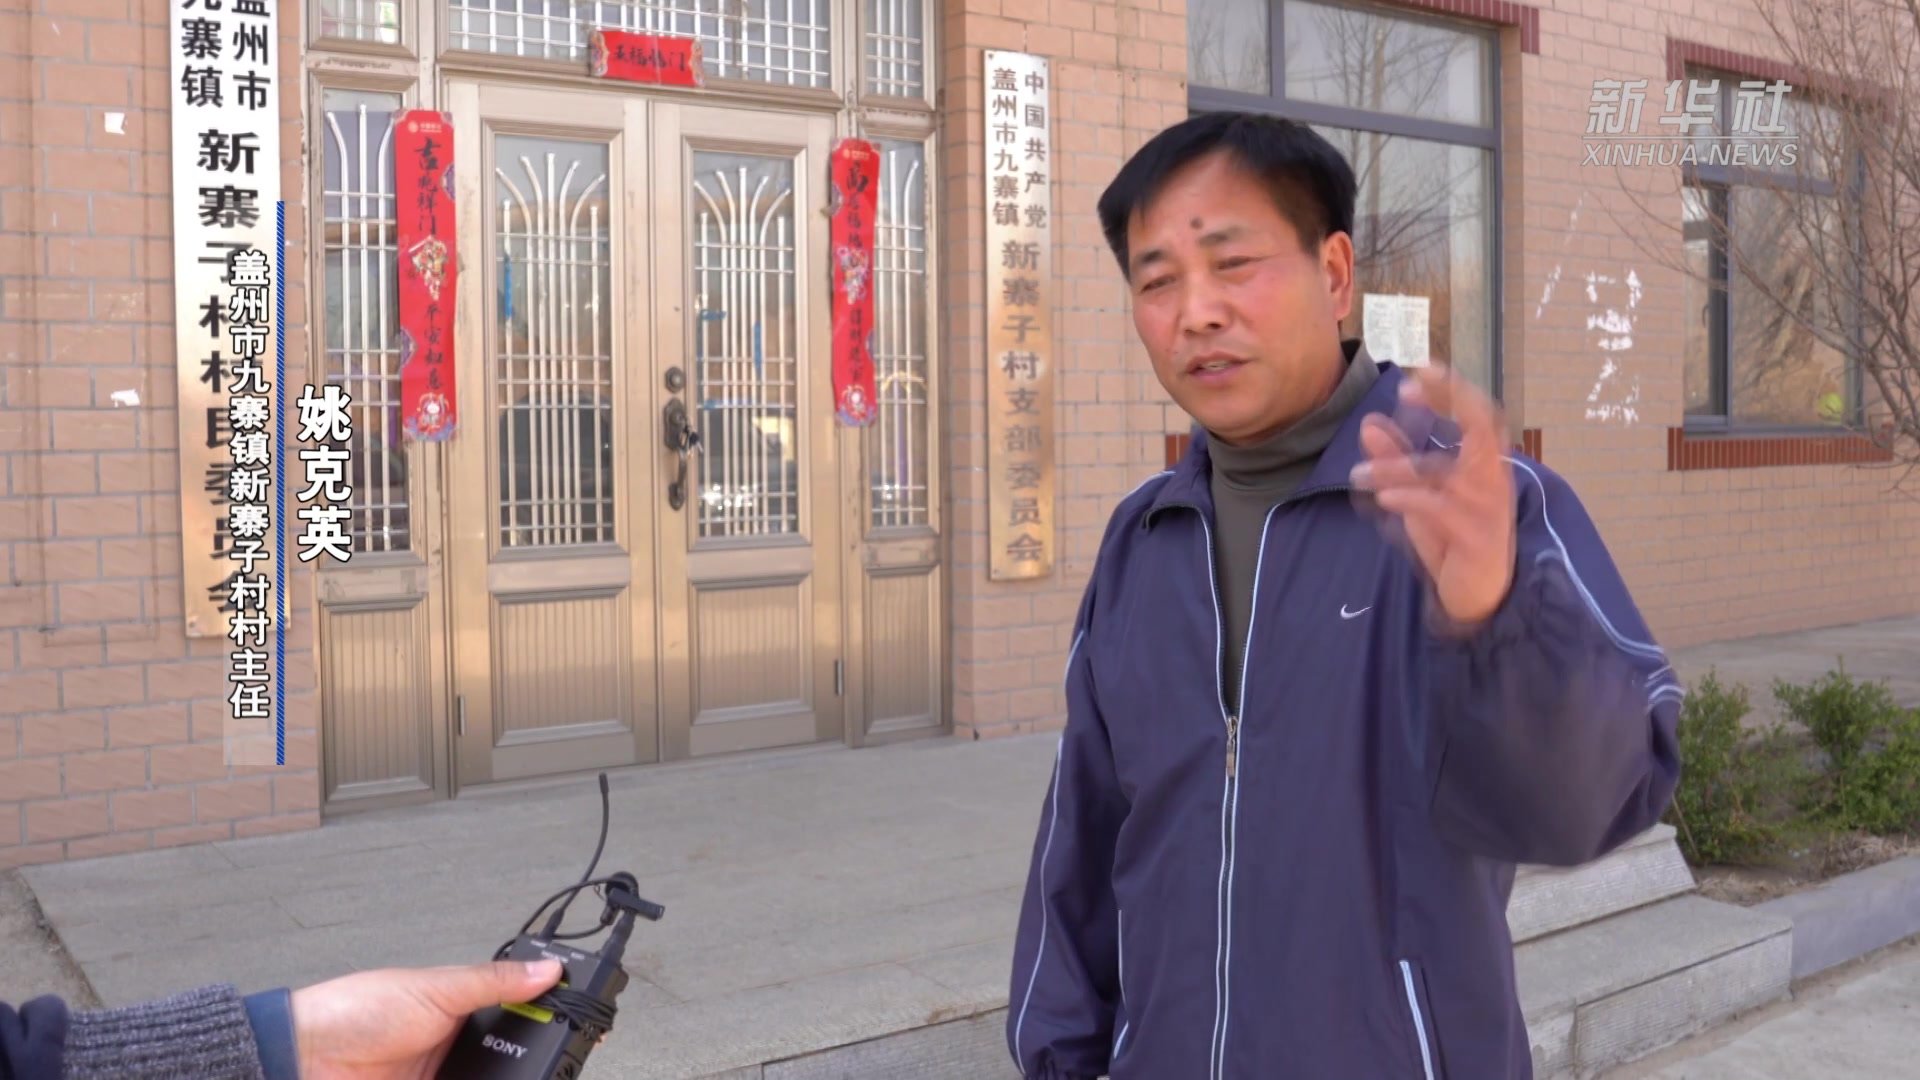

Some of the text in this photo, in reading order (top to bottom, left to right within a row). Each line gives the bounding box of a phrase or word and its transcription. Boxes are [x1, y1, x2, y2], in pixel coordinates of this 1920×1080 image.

[181, 0, 223, 108] 寨镇
[991, 67, 1020, 227] 盖州市九寨镇
[1024, 70, 1047, 229] 中国共产党
[1002, 240, 1043, 562] 新寨子村支部委员会
[482, 1034, 528, 1058] SONY
